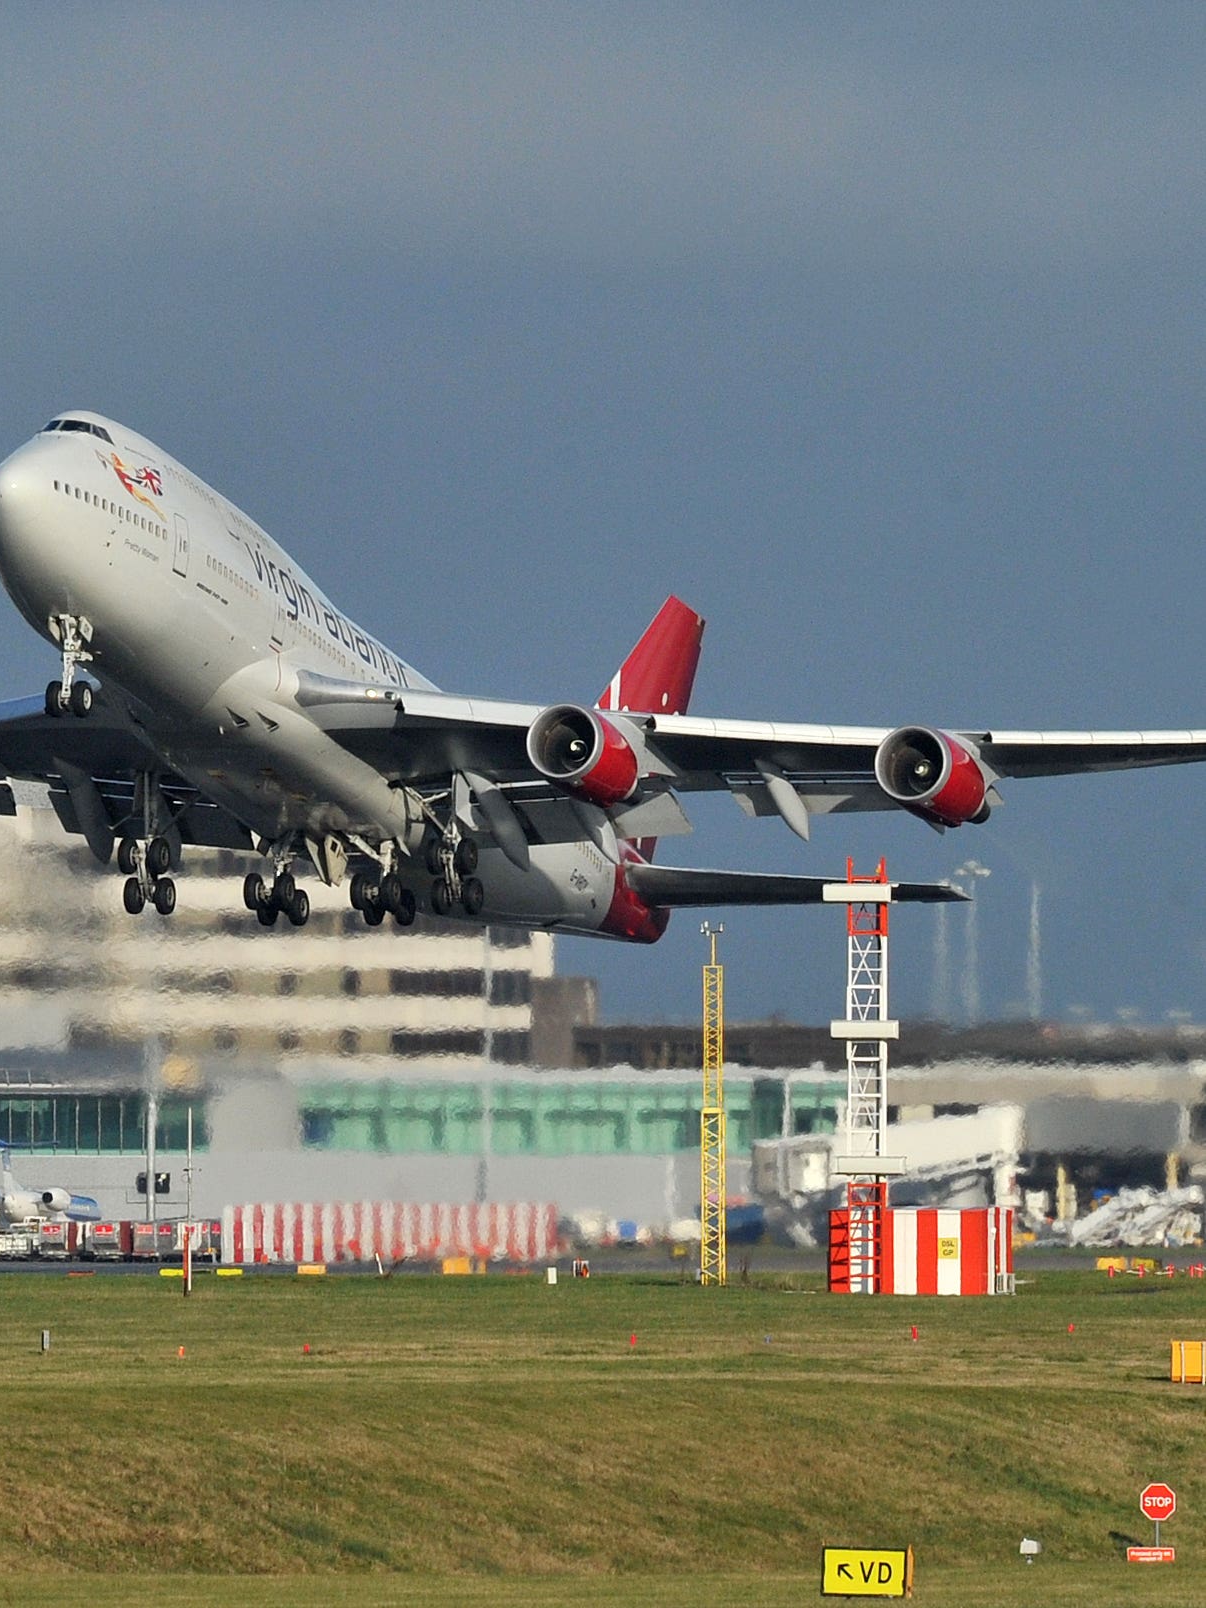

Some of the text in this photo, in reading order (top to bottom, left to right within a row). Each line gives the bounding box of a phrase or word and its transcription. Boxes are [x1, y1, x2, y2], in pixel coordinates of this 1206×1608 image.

[245, 543, 320, 625] virgin
[1144, 1496, 1172, 1507] STOP
[859, 1560, 893, 1584] VD
